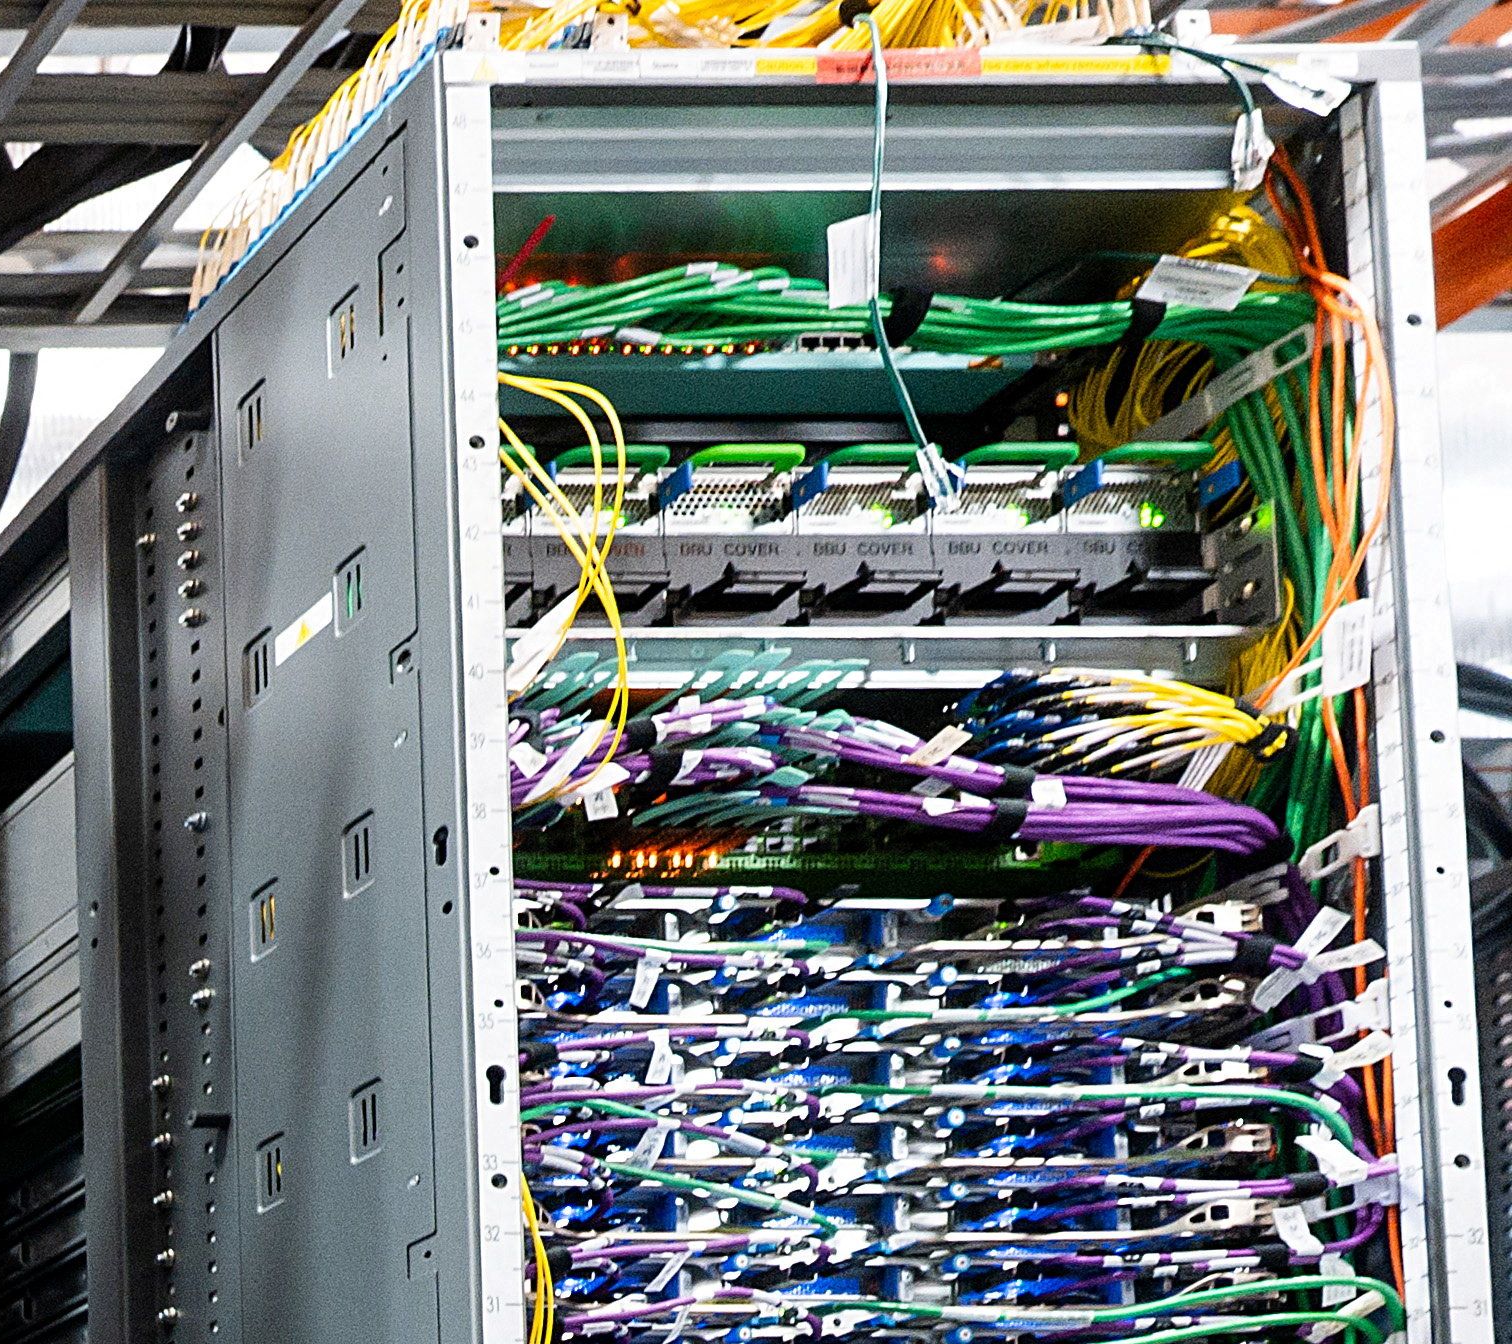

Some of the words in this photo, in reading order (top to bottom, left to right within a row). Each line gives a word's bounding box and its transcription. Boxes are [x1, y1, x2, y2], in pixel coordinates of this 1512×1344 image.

[479, 1012, 493, 1028] 35
[484, 1155, 498, 1171] 33
[486, 1226, 500, 1242] 32
